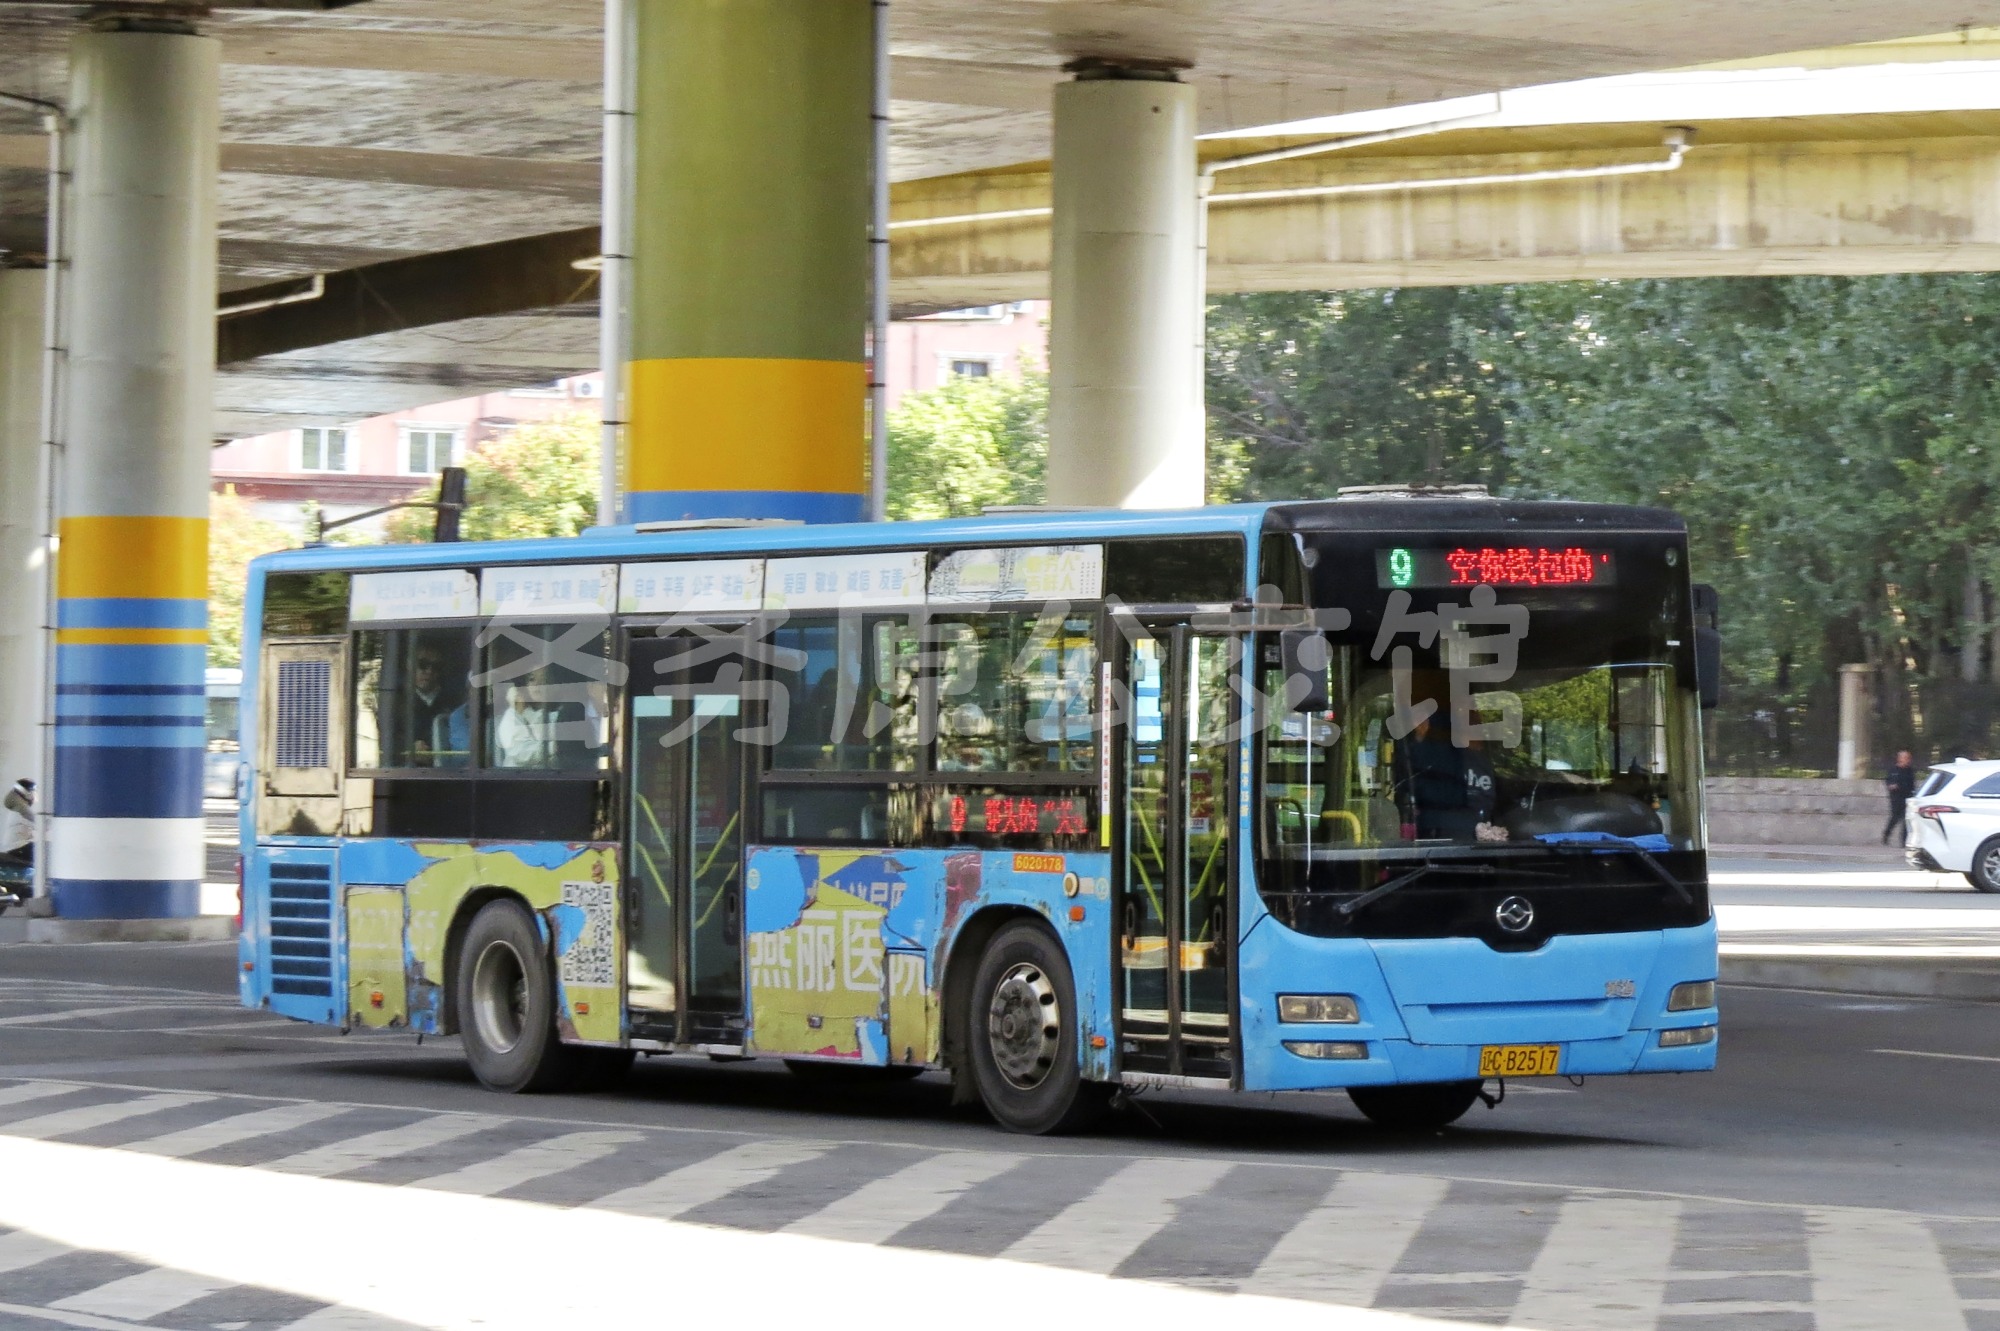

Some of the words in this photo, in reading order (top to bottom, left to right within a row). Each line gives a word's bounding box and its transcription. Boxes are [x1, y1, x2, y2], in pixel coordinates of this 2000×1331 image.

[1390, 548, 1412, 585] 9
[1464, 769, 1492, 790] he
[1015, 855, 1062, 871] 6020178
